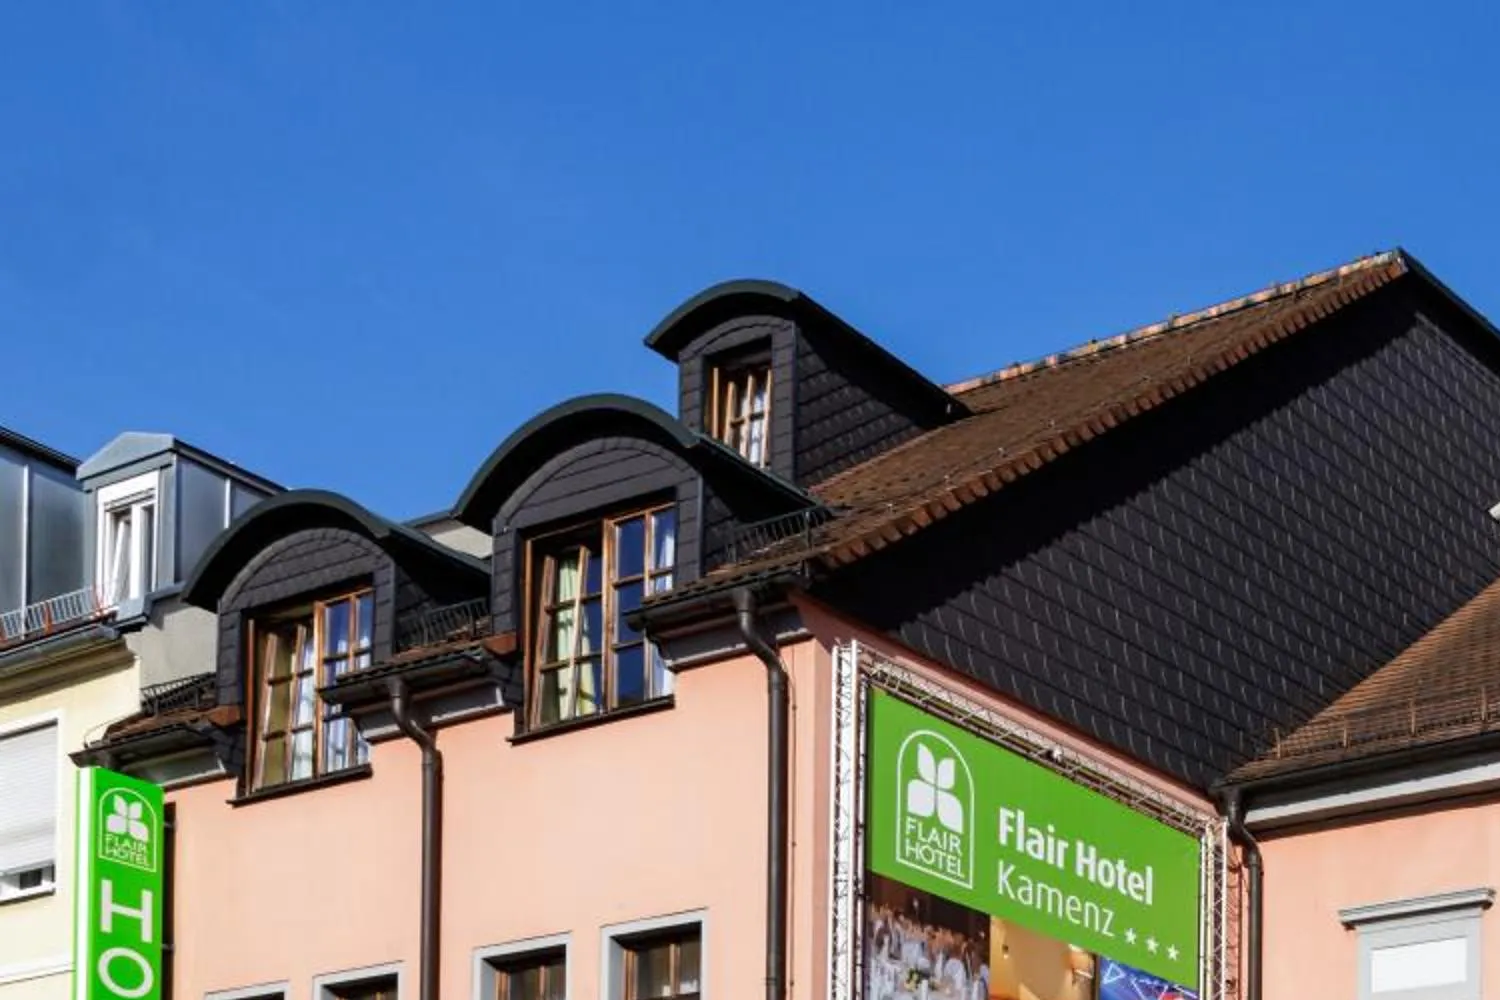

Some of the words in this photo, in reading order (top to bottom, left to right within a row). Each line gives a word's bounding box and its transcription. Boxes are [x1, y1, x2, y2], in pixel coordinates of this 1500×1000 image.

[104, 833, 148, 855] FLAIR
[104, 847, 150, 867] HOTEL
[905, 816, 963, 857] FLAIR
[1000, 806, 1068, 869] Flair
[1076, 840, 1153, 905] Hotel
[905, 837, 965, 878] HOTEL
[998, 859, 1115, 937] Kamenz
